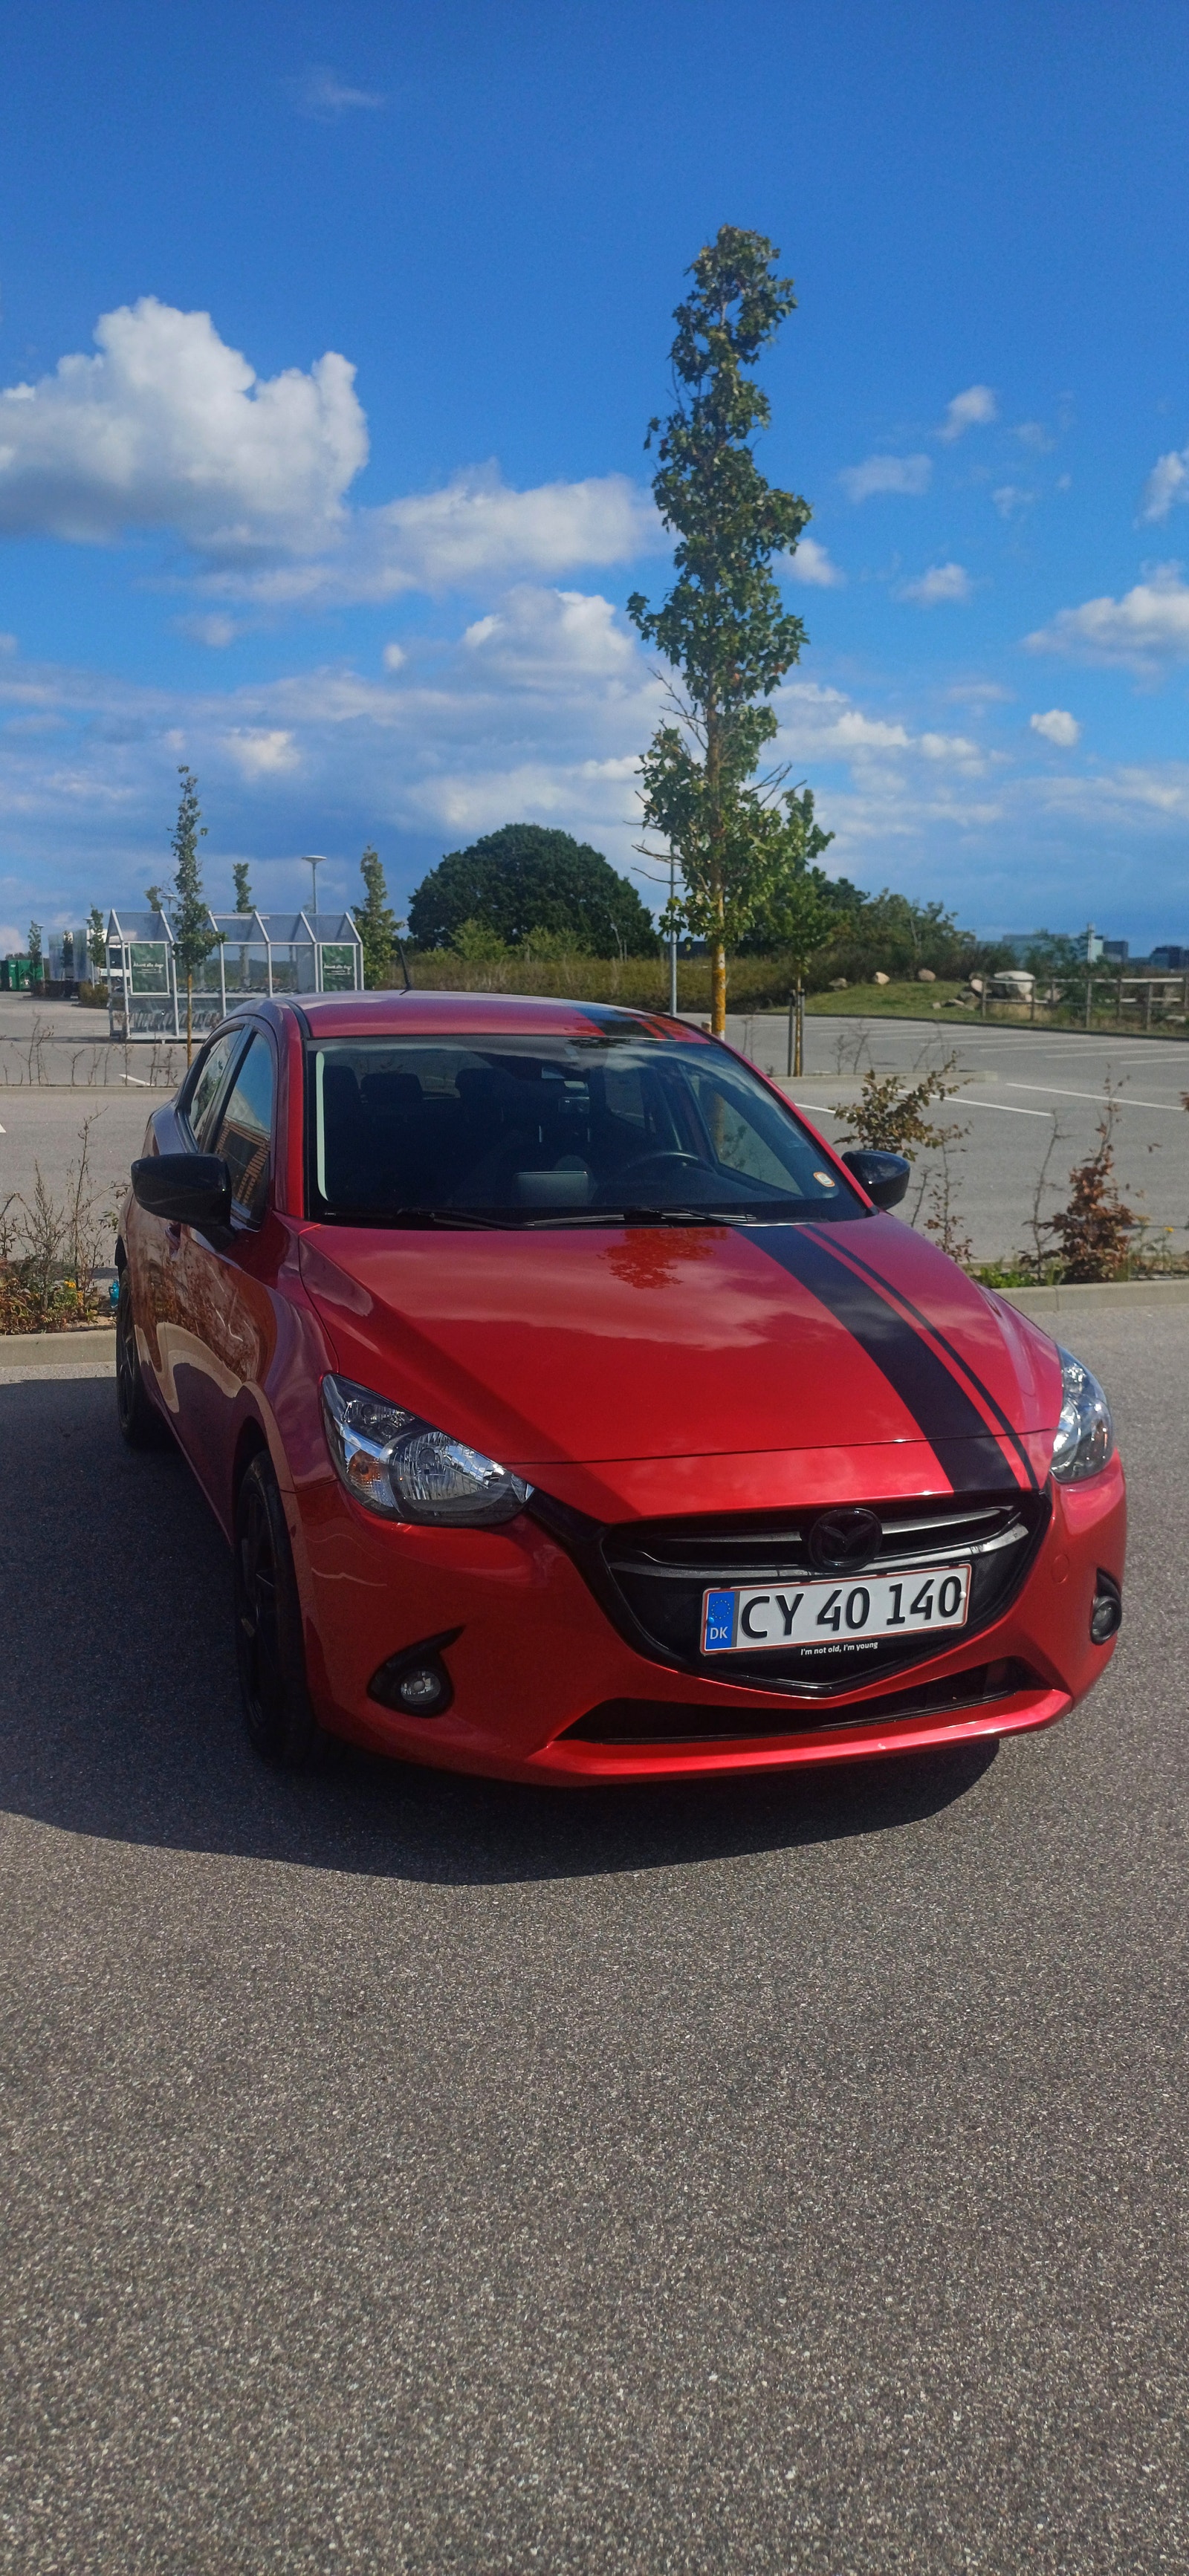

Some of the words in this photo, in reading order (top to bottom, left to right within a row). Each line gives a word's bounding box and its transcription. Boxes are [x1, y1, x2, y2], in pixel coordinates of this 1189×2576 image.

[742, 1593, 804, 1638] CY
[817, 1587, 870, 1631] 40
[887, 1576, 962, 1625] 140
[710, 1626, 728, 1640] DK
[814, 1647, 826, 1655] not
[828, 1645, 842, 1653] old,
[856, 1642, 878, 1651] young
